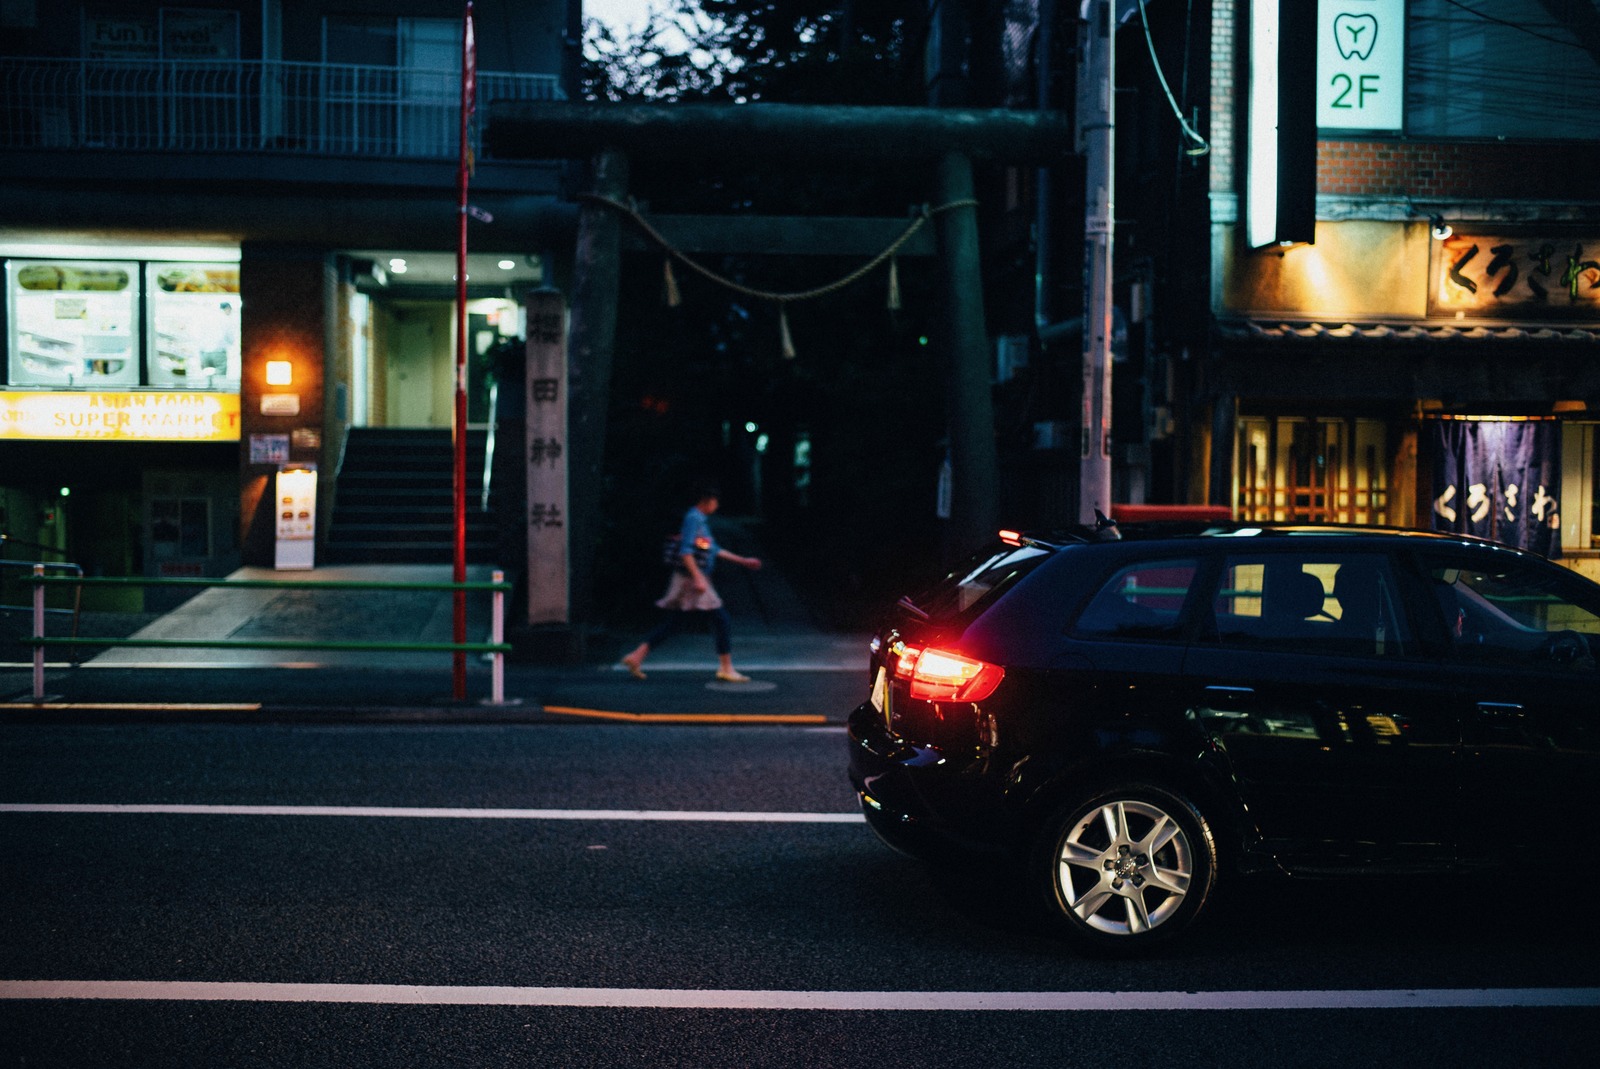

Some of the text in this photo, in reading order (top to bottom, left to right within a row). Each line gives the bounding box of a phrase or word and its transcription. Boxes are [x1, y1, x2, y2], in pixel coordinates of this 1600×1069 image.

[95, 22, 138, 42] Fun
[1331, 73, 1380, 109] 2F
[1449, 242, 1600, 301] くろさわ
[54, 412, 131, 428] SUPER
[1434, 483, 1560, 530] くろさわ
